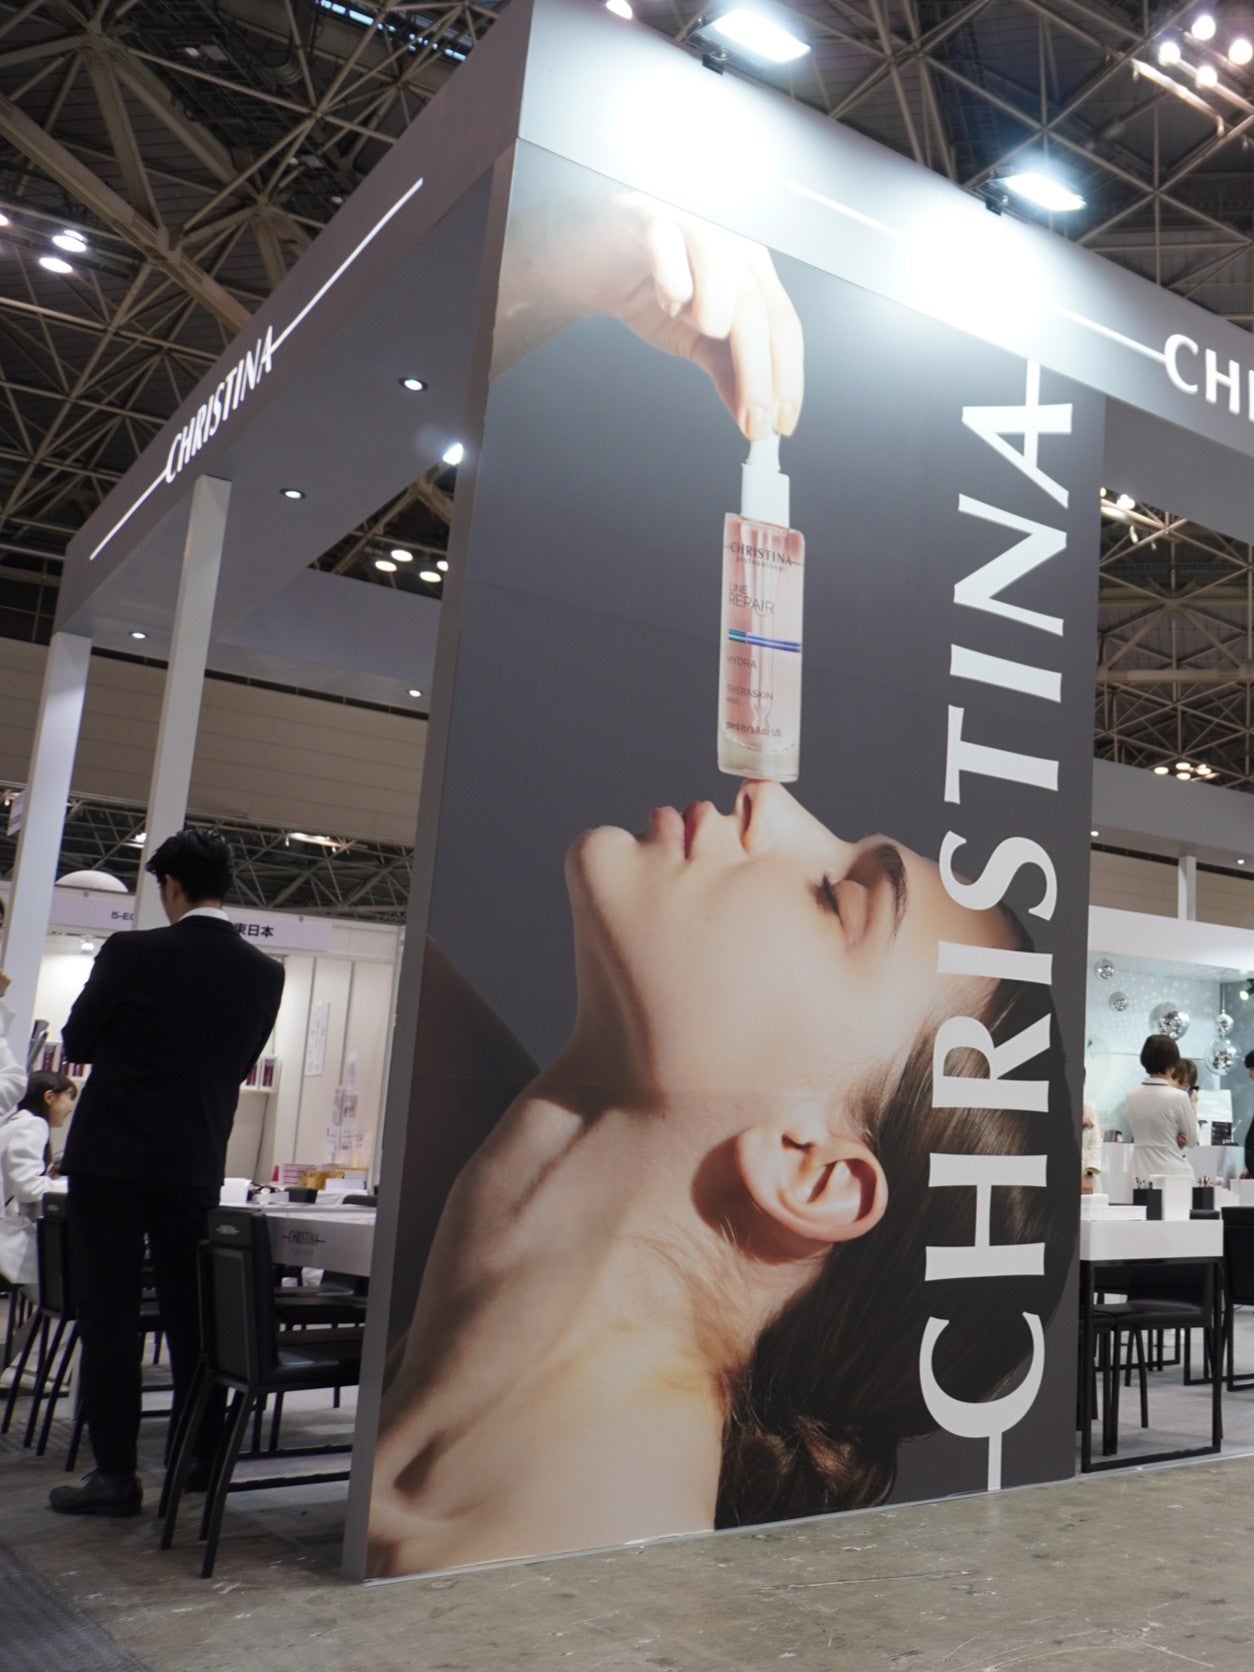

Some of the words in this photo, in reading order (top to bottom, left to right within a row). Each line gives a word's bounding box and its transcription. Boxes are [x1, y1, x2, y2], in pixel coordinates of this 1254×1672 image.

[165, 325, 273, 484] CHRISTINA
[730, 541, 792, 566] CHRISTINA
[728, 592, 774, 614] REPAIR
[726, 655, 757, 669] HYDRA
[726, 684, 774, 701] THERASKIN
[918, 403, 1073, 1438] CHRISTINA
